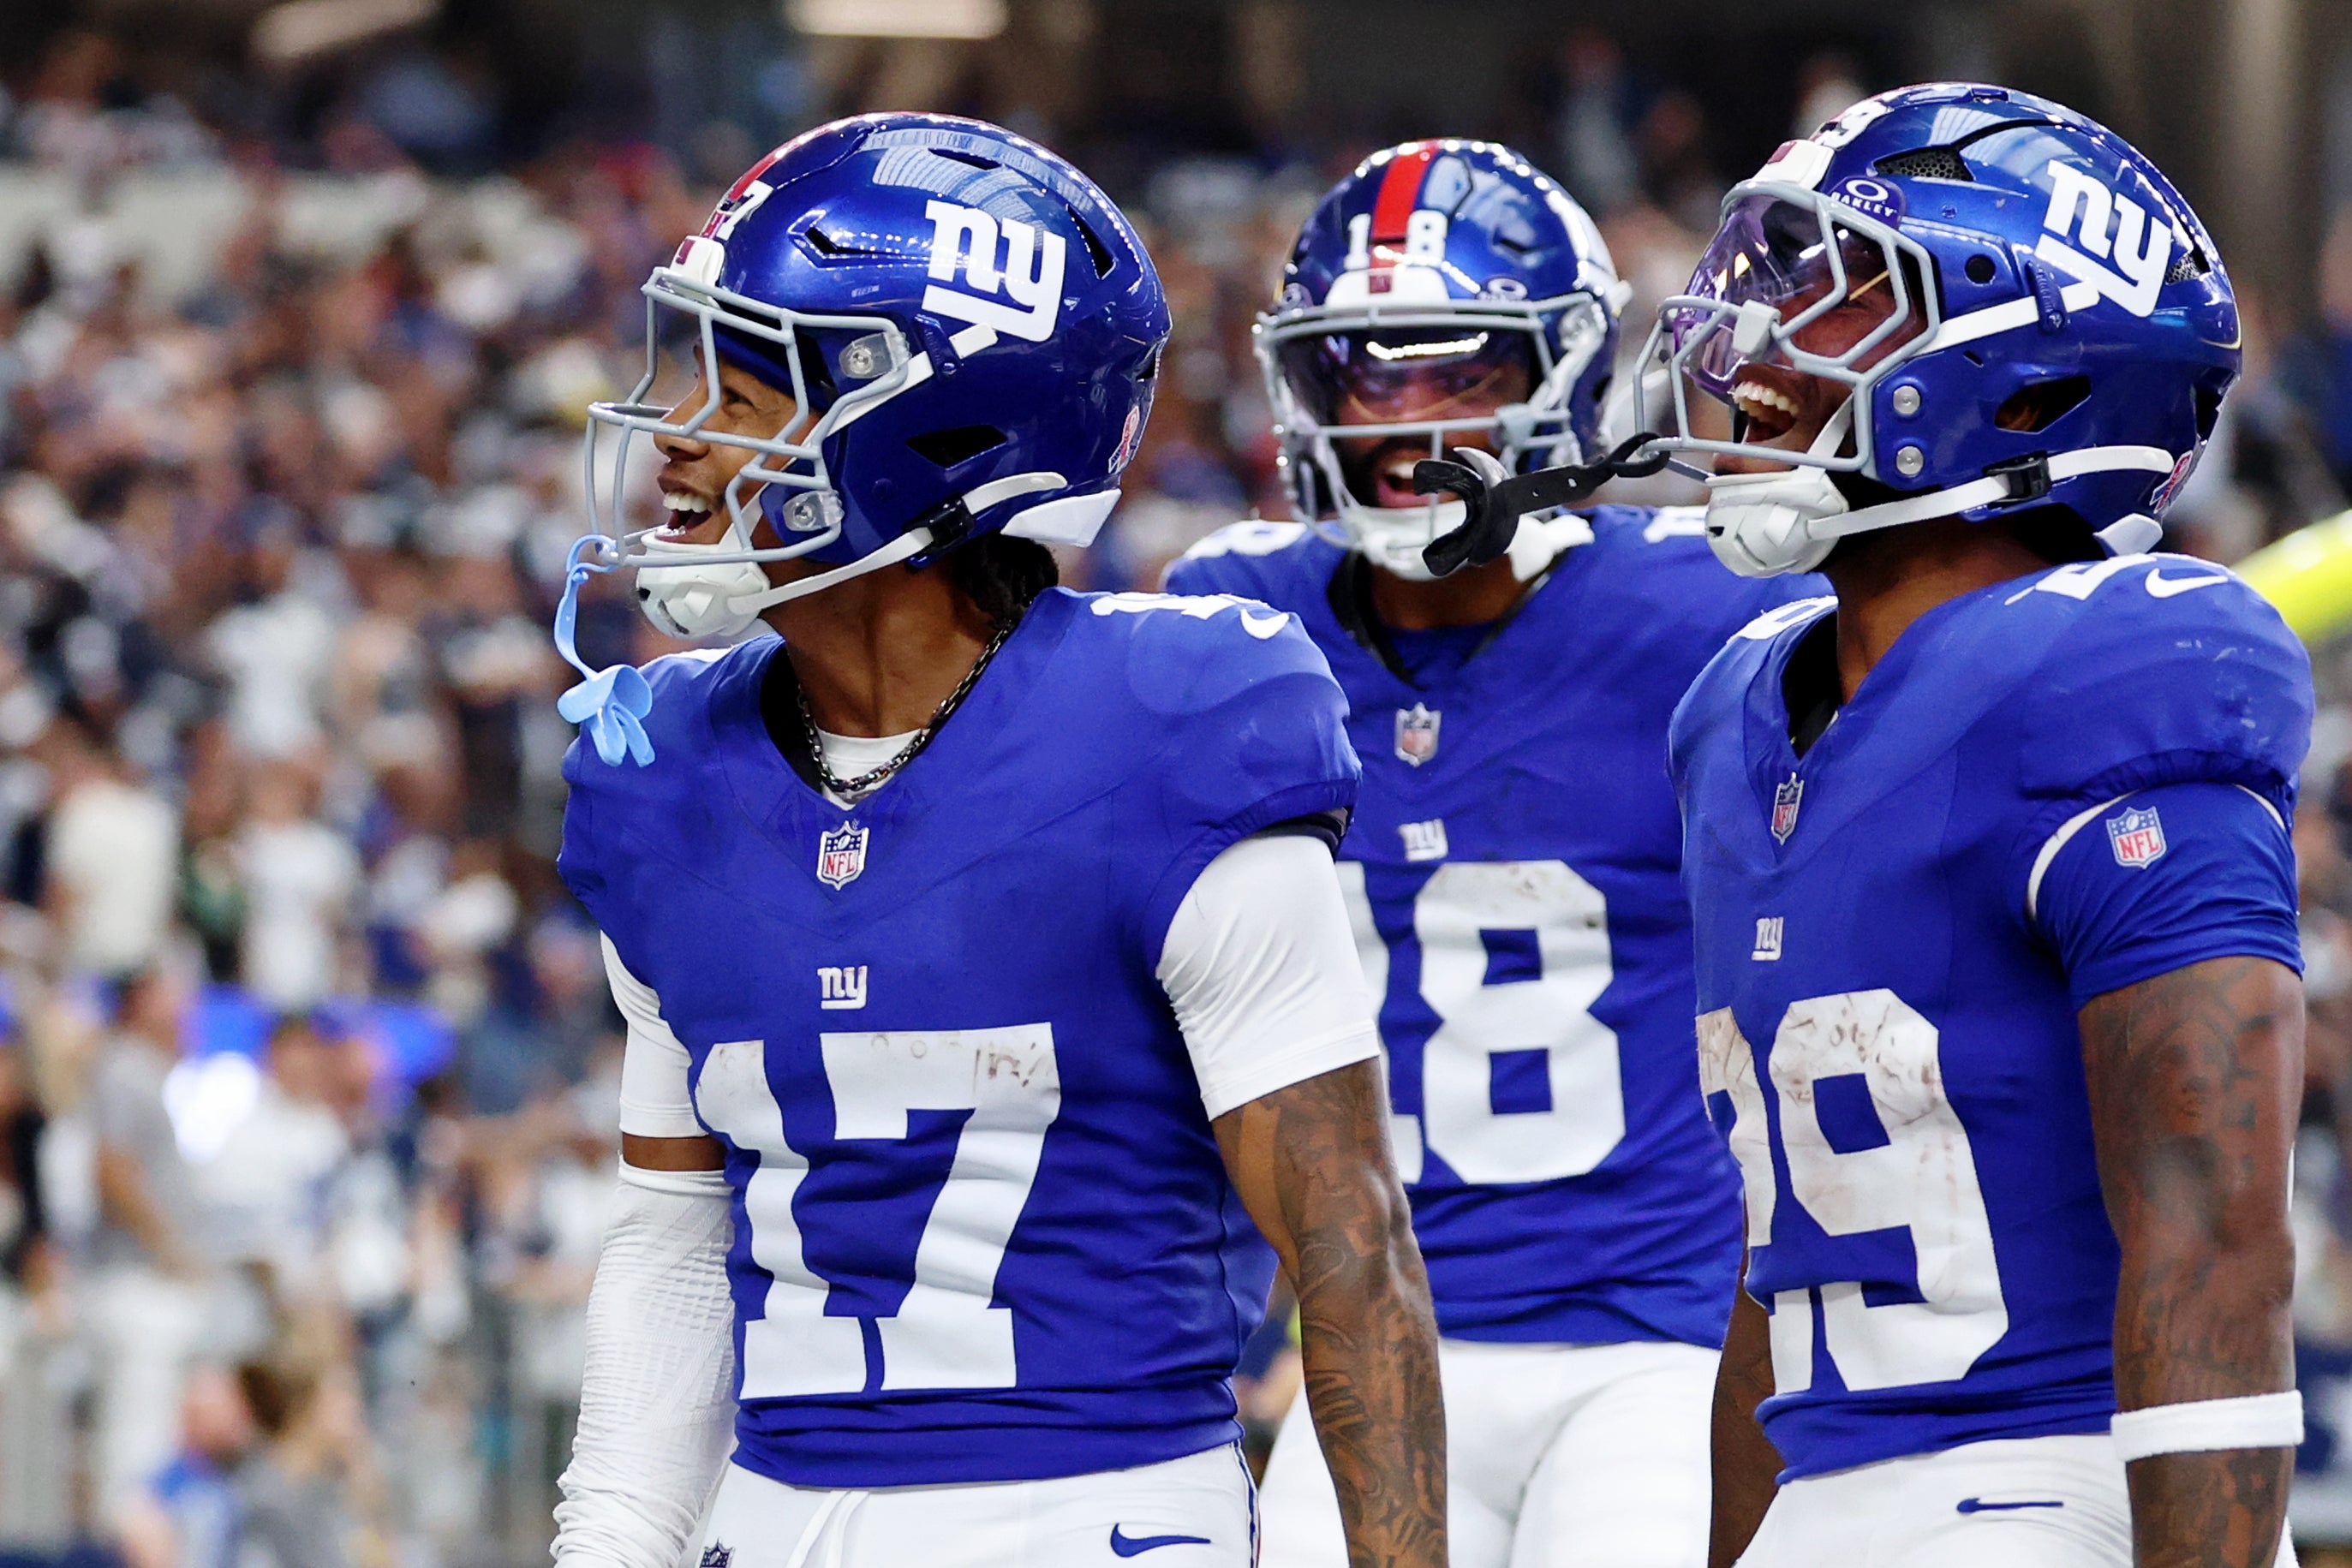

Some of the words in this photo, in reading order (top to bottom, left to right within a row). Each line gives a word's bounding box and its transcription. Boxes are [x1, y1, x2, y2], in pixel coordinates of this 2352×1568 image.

[1831, 191, 1896, 218] OAKLEY
[1343, 209, 1448, 271] 18
[2117, 830, 2160, 860] NFL
[825, 851, 856, 878] NFL
[694, 1021, 1062, 1400] 17
